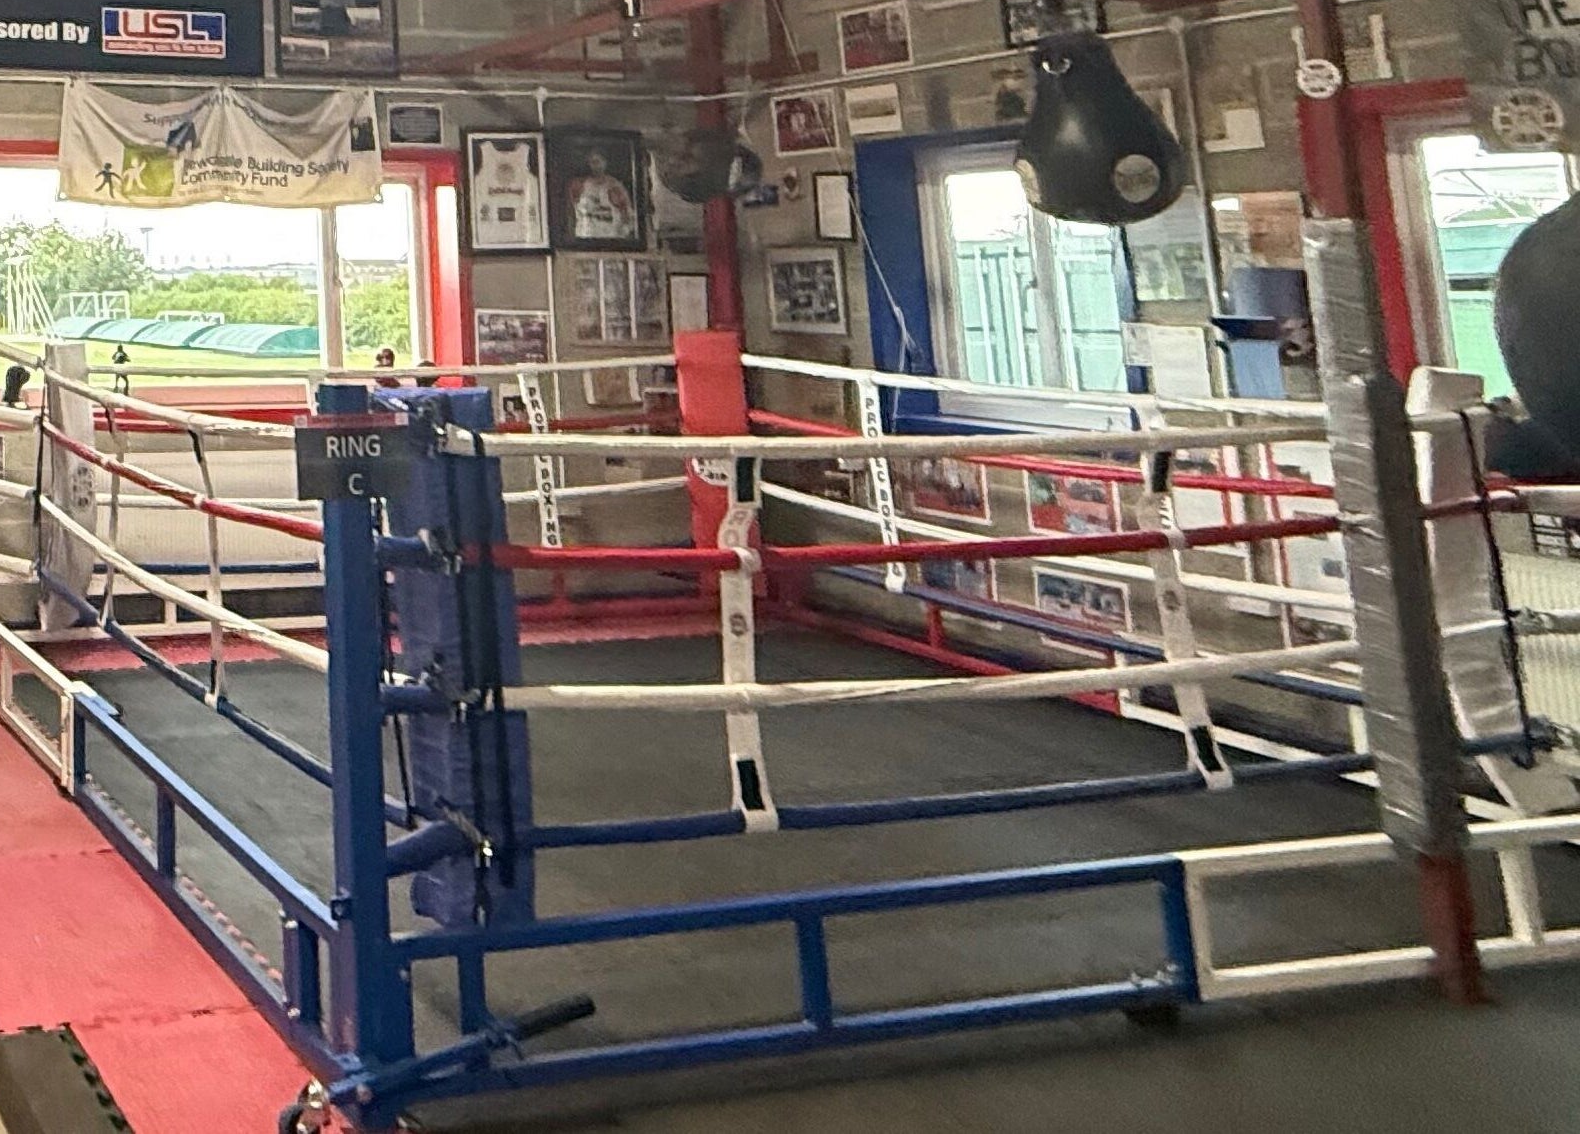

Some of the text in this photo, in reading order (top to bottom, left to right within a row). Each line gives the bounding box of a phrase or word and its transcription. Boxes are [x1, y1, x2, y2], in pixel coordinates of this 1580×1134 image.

[62, 21, 90, 44] By
[123, 10, 207, 41] USL
[248, 156, 305, 177] Building
[252, 172, 288, 187] Fund
[325, 434, 381, 459] RING
[348, 473, 364, 495] C
[541, 467, 558, 546] BOXING
